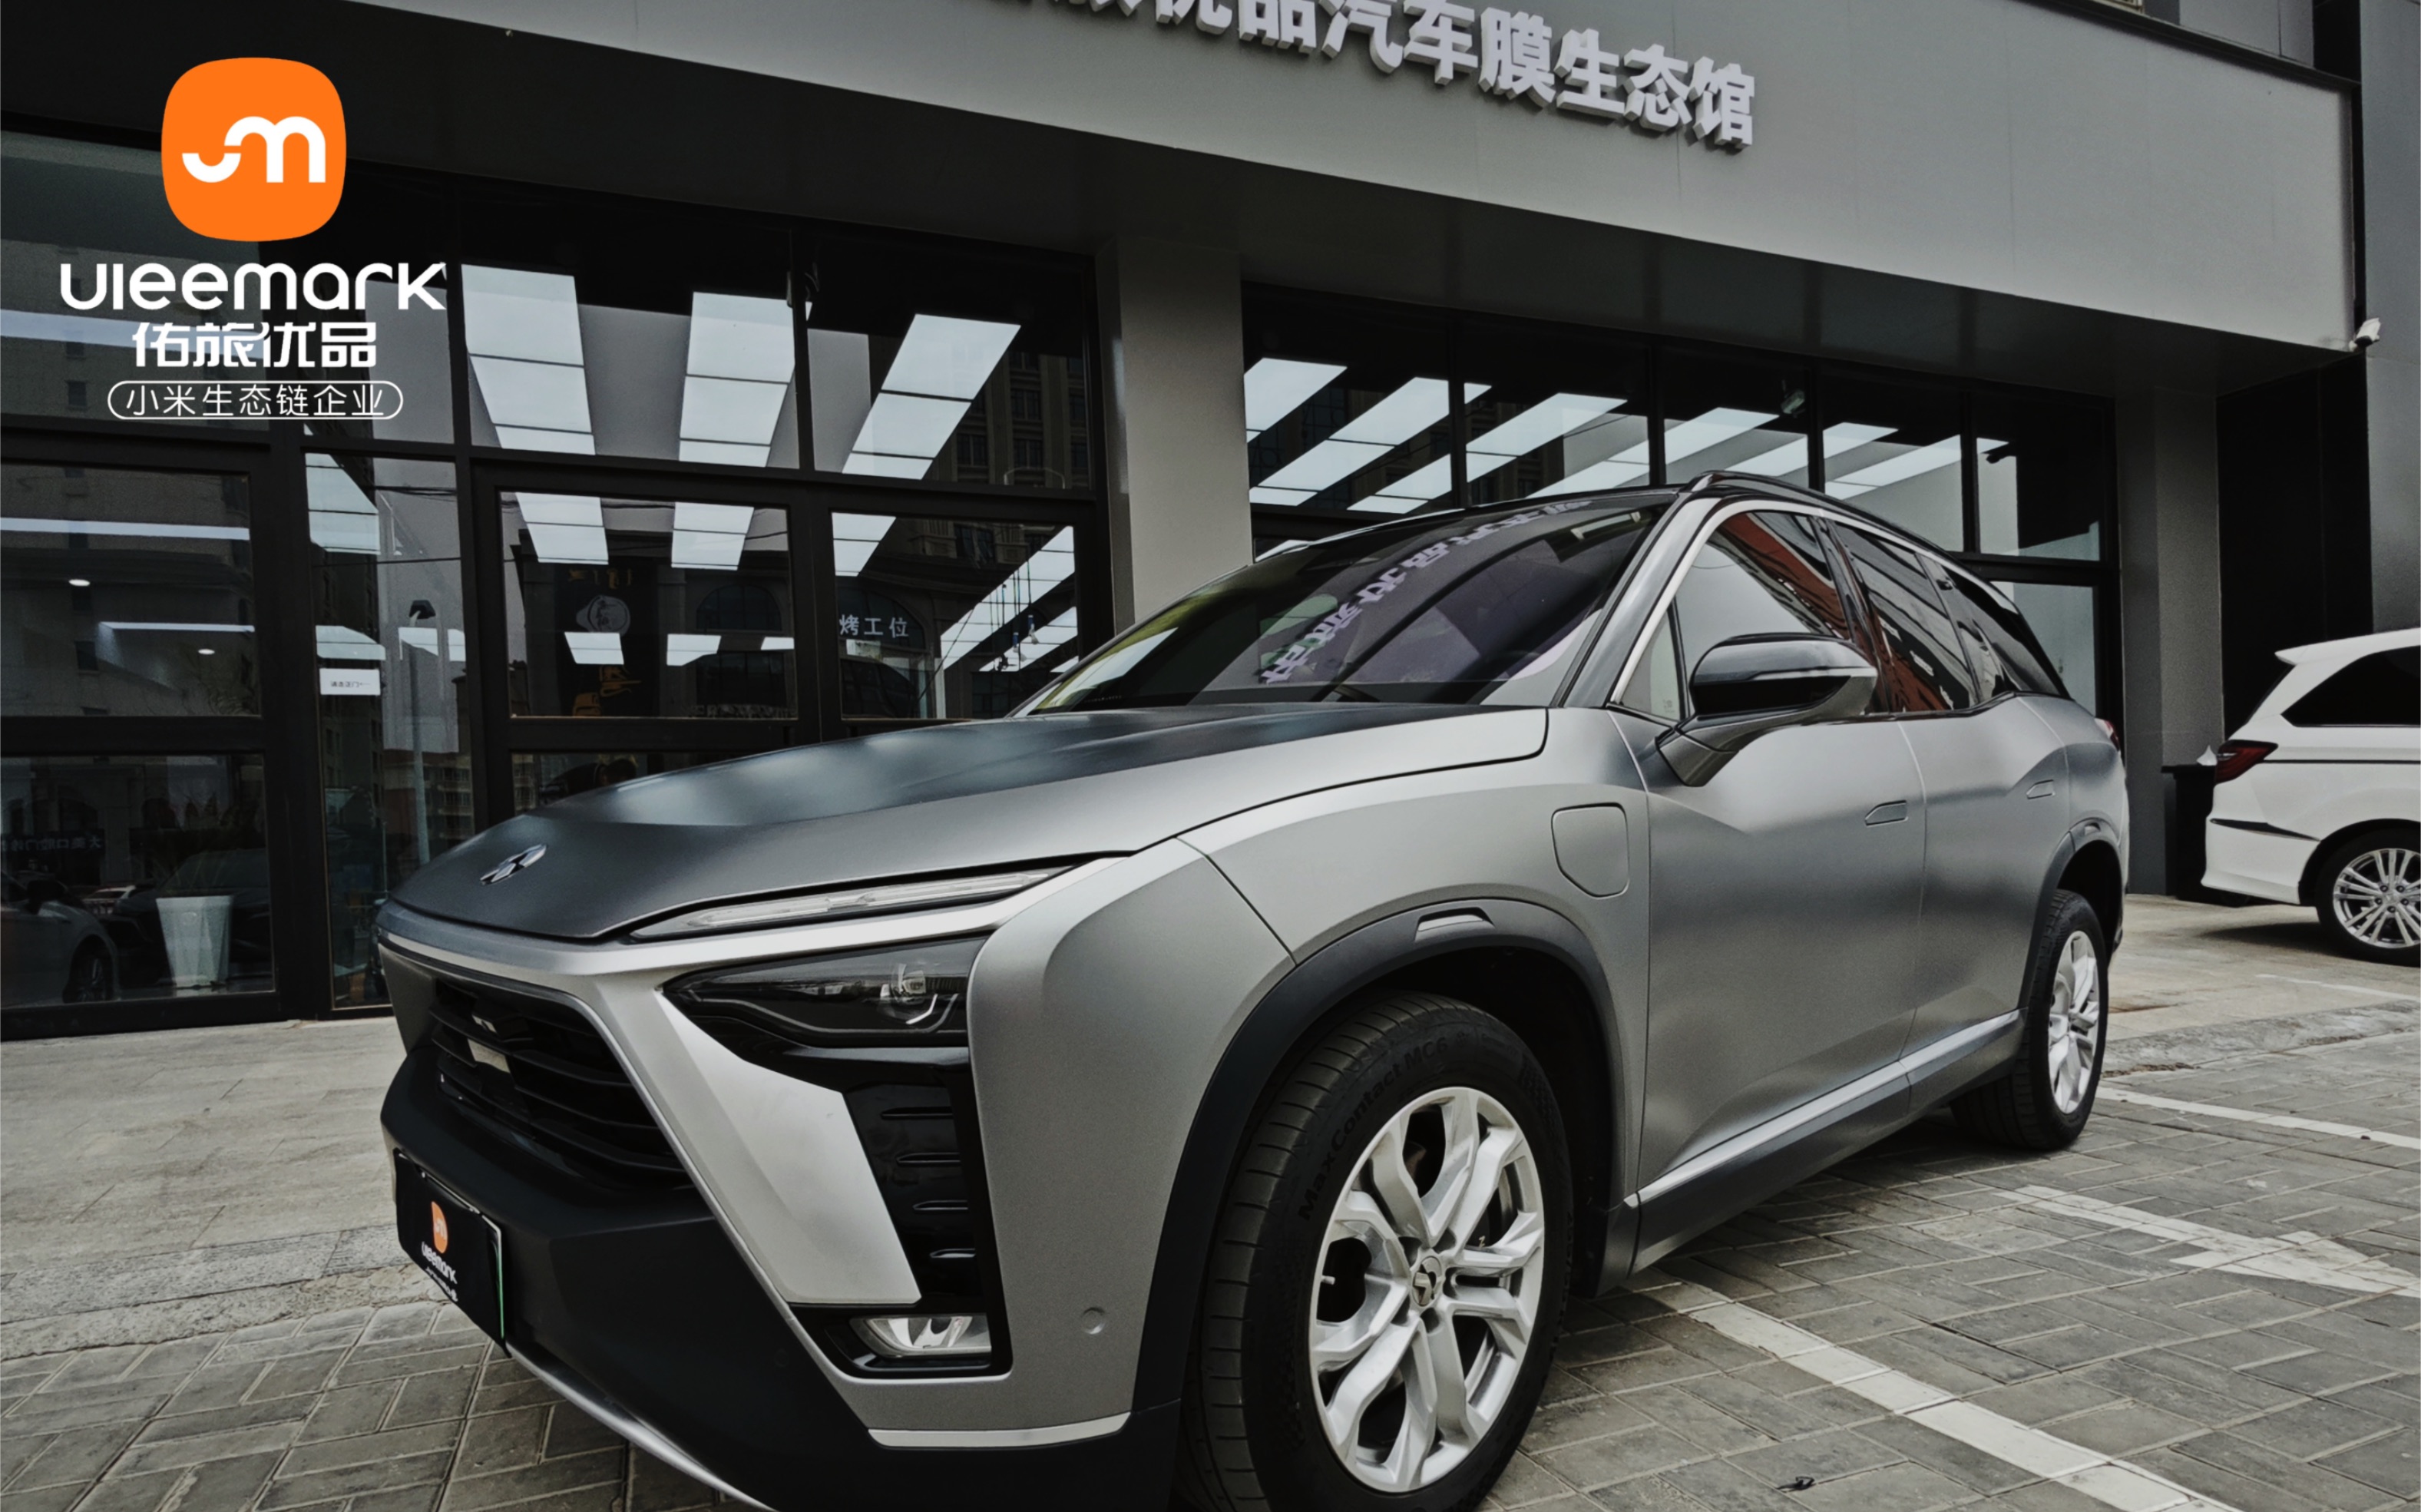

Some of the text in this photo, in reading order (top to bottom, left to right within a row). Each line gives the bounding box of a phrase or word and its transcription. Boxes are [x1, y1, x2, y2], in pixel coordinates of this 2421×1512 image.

[1055, 0, 1755, 148] 品汽车膜生态馆
[838, 614, 909, 638] 烤工位
[1298, 1036, 1449, 1221] MaxContact MC6
